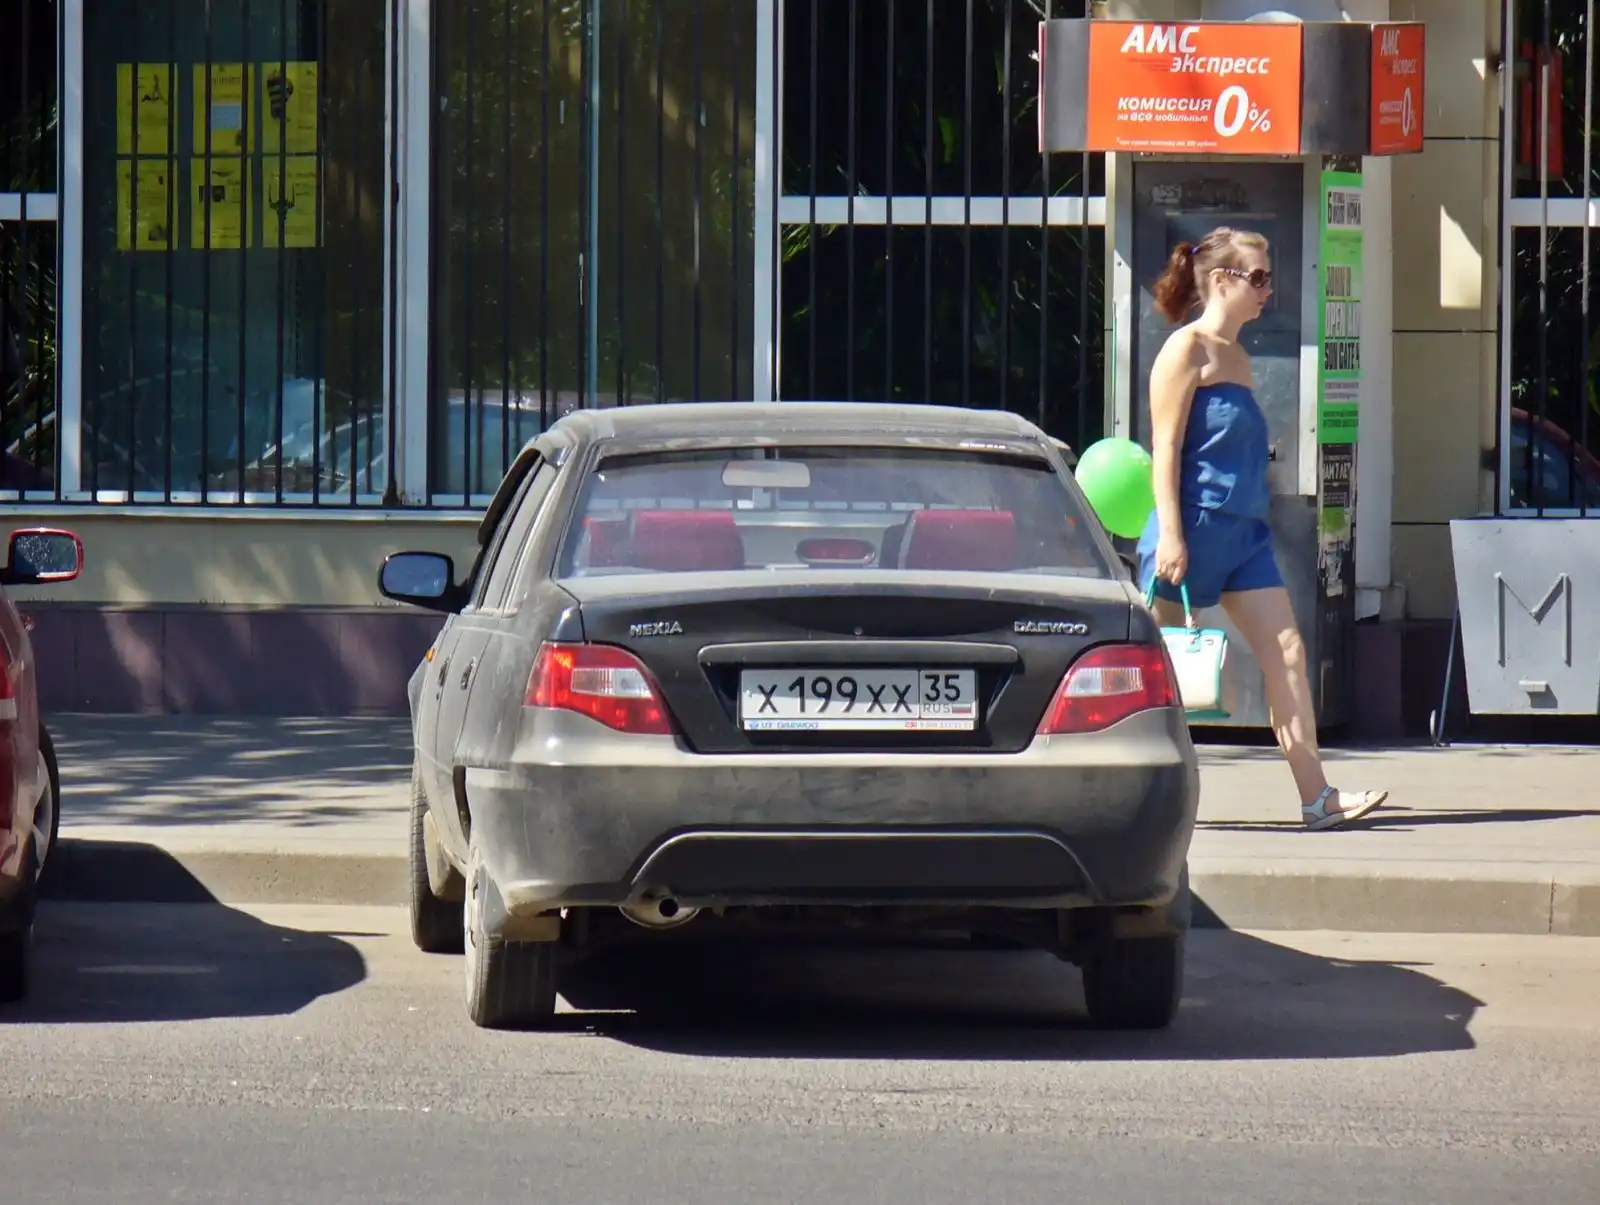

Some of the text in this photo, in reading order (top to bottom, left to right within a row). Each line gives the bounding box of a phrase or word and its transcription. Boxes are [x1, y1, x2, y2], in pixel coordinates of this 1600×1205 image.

[1120, 23, 1200, 53] АМС
[1169, 54, 1270, 77] экспресс
[1117, 97, 1213, 112] комиссия
[630, 621, 683, 637] NEXIA
[1013, 621, 1088, 634] DAEWOO
[924, 673, 961, 702] 35
[922, 702, 951, 714] RUS
